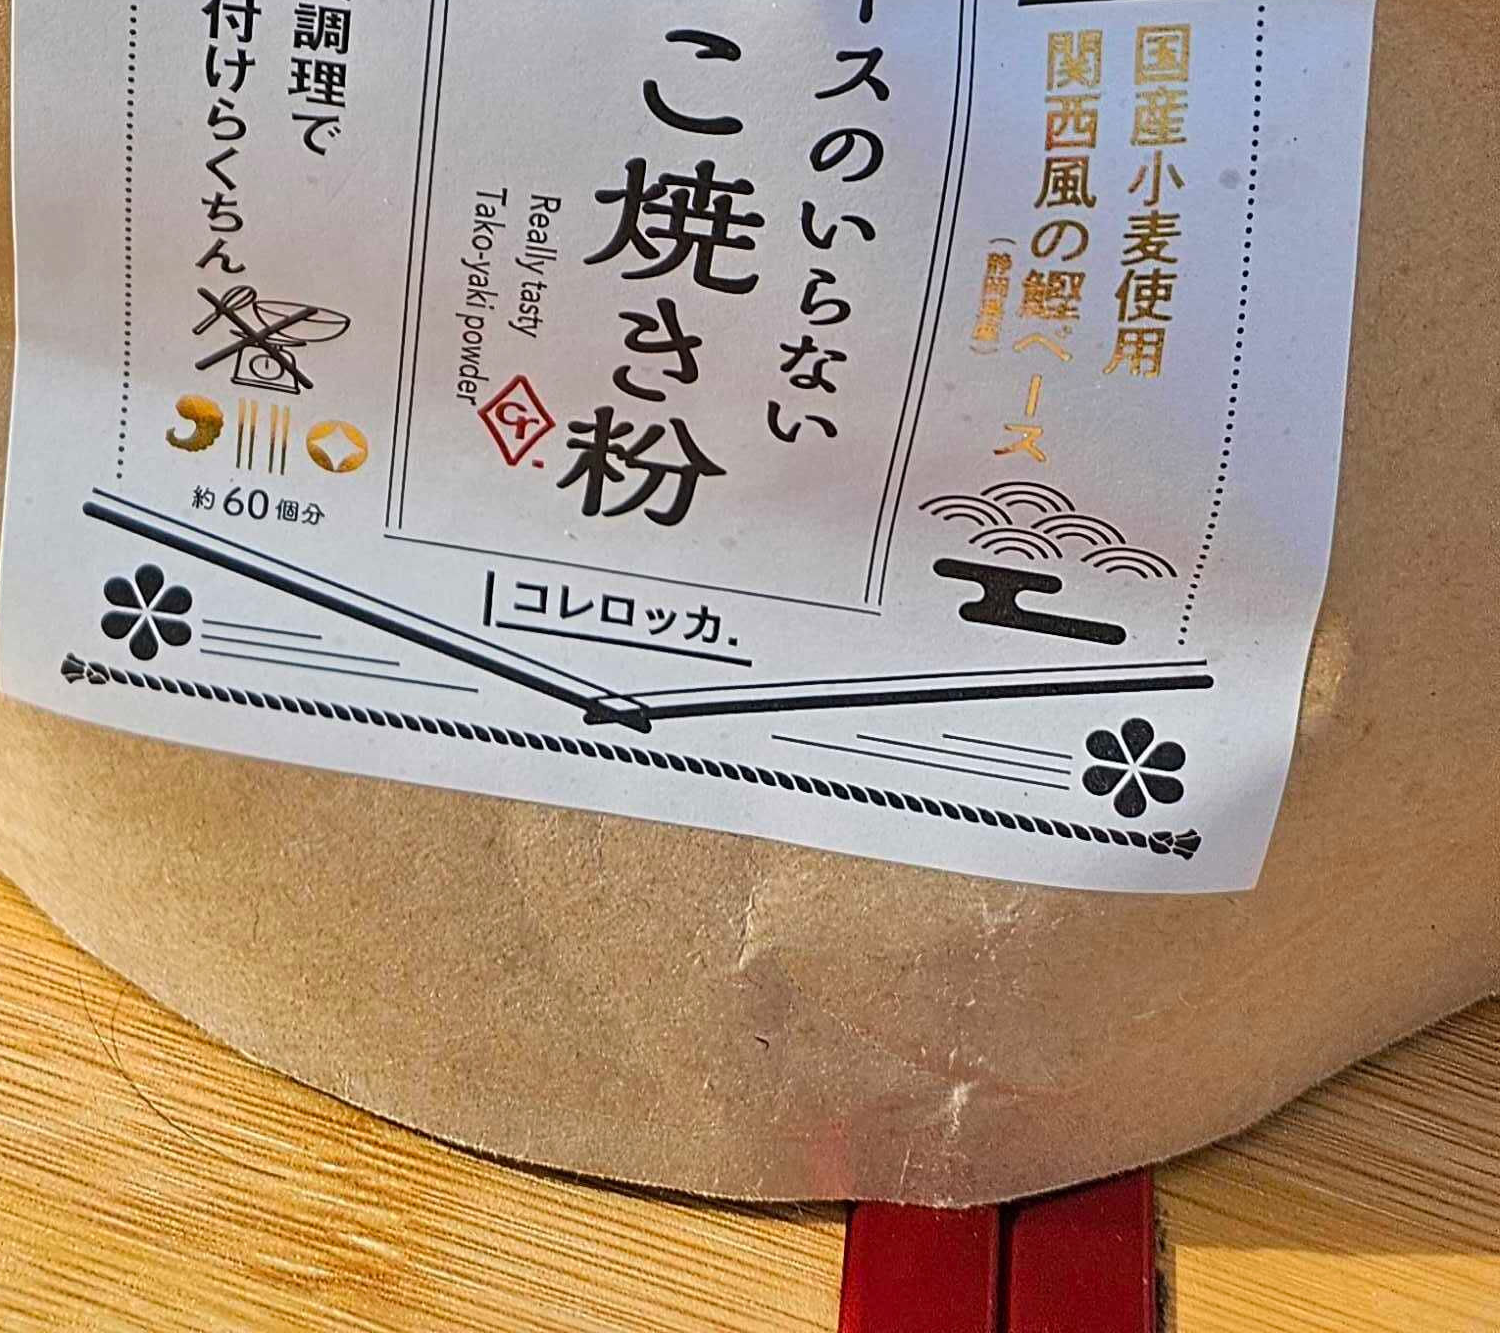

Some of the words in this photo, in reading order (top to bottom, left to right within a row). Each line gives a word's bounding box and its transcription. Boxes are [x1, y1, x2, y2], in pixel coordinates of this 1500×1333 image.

[460, 188, 508, 310] Tako-yaki
[515, 194, 562, 276] Really
[993, 29, 1104, 465] 関西風の鰹ベース
[1103, 23, 1191, 377] 国産小麦使用
[455, 312, 490, 406] powder
[508, 280, 547, 338] tasty
